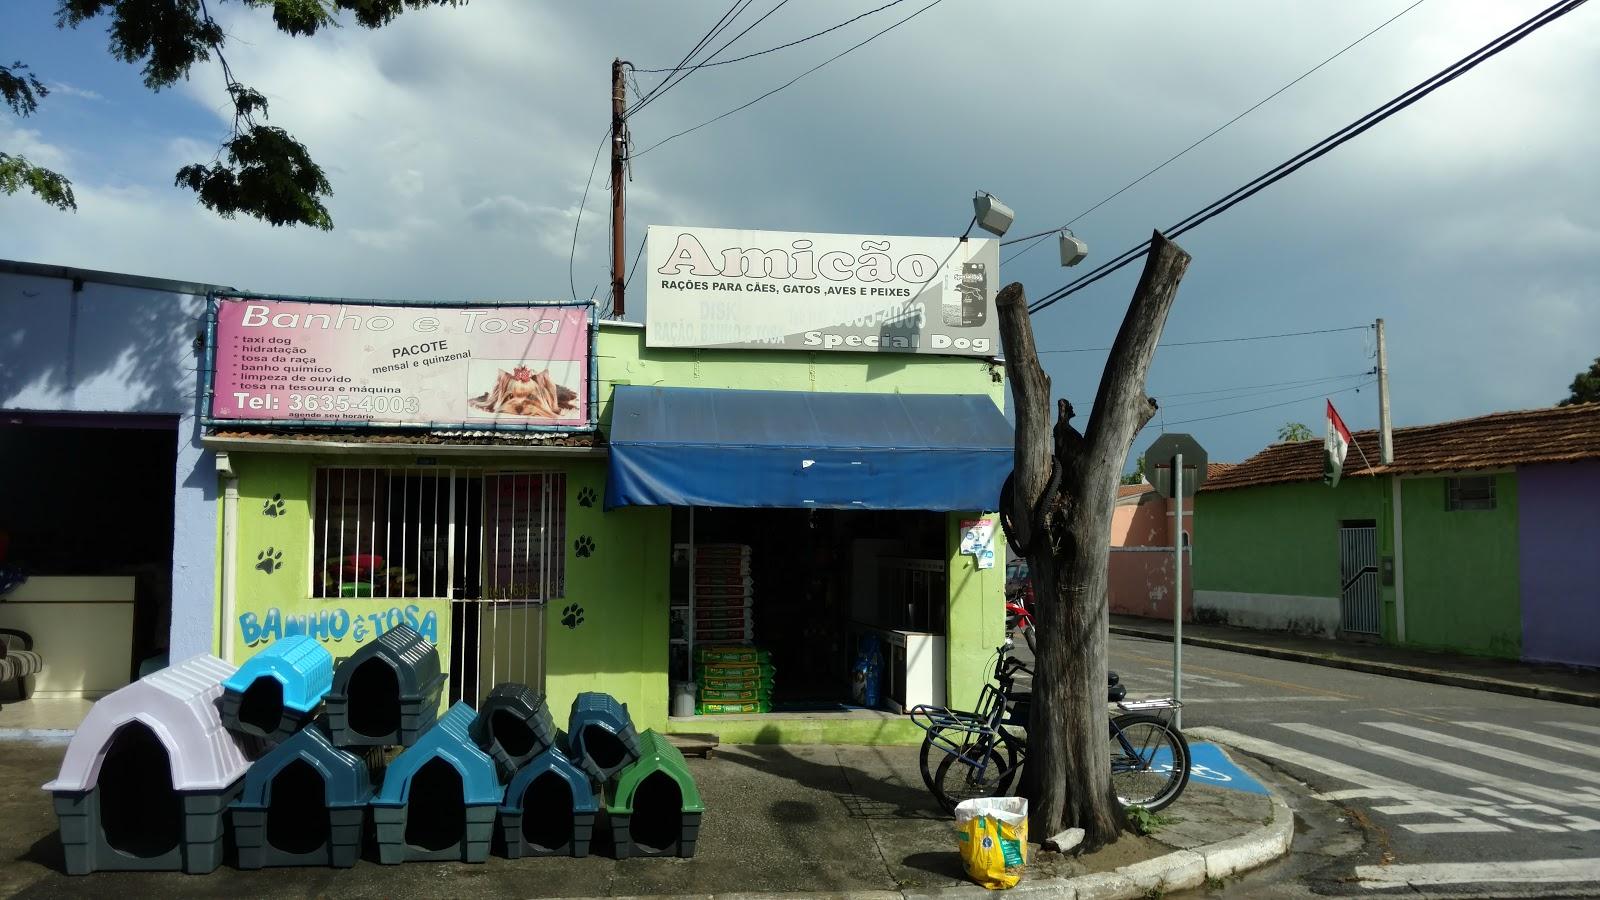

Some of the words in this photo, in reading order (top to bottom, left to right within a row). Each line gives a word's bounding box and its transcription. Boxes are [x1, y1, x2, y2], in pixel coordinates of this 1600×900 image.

[658, 233, 939, 283] Amicão
[661, 280, 709, 292] RAÇÕES
[713, 282, 742, 292] PARA
[746, 281, 779, 294] CÃES,
[783, 284, 821, 294] GATOS
[860, 287, 867, 295] E
[870, 287, 911, 297] PEIXES
[242, 305, 395, 331] Banho
[413, 316, 440, 332] e
[460, 310, 561, 335] Tosa
[242, 336, 264, 344] taxi
[268, 336, 291, 345] dog
[393, 340, 448, 358] PACOTE
[804, 331, 920, 350] Special
[931, 333, 990, 352] Dog
[242, 345, 307, 354] hidratação
[241, 354, 268, 362] tosa
[272, 354, 286, 363] da
[290, 357, 316, 365] raça
[241, 363, 279, 372] banho
[372, 361, 409, 375] mensal
[422, 350, 471, 368] quinzenal
[240, 372, 288, 382] limpeza
[291, 374, 306, 382] de
[310, 375, 351, 383] ouvido
[240, 382, 267, 390] tosa
[289, 383, 334, 392] tesoura
[349, 385, 401, 394] máquina
[233, 392, 280, 410] Tel:
[288, 393, 420, 414] 3635-4003
[239, 607, 350, 645] BANHO
[352, 614, 369, 642] &
[368, 604, 439, 645] TOSA
